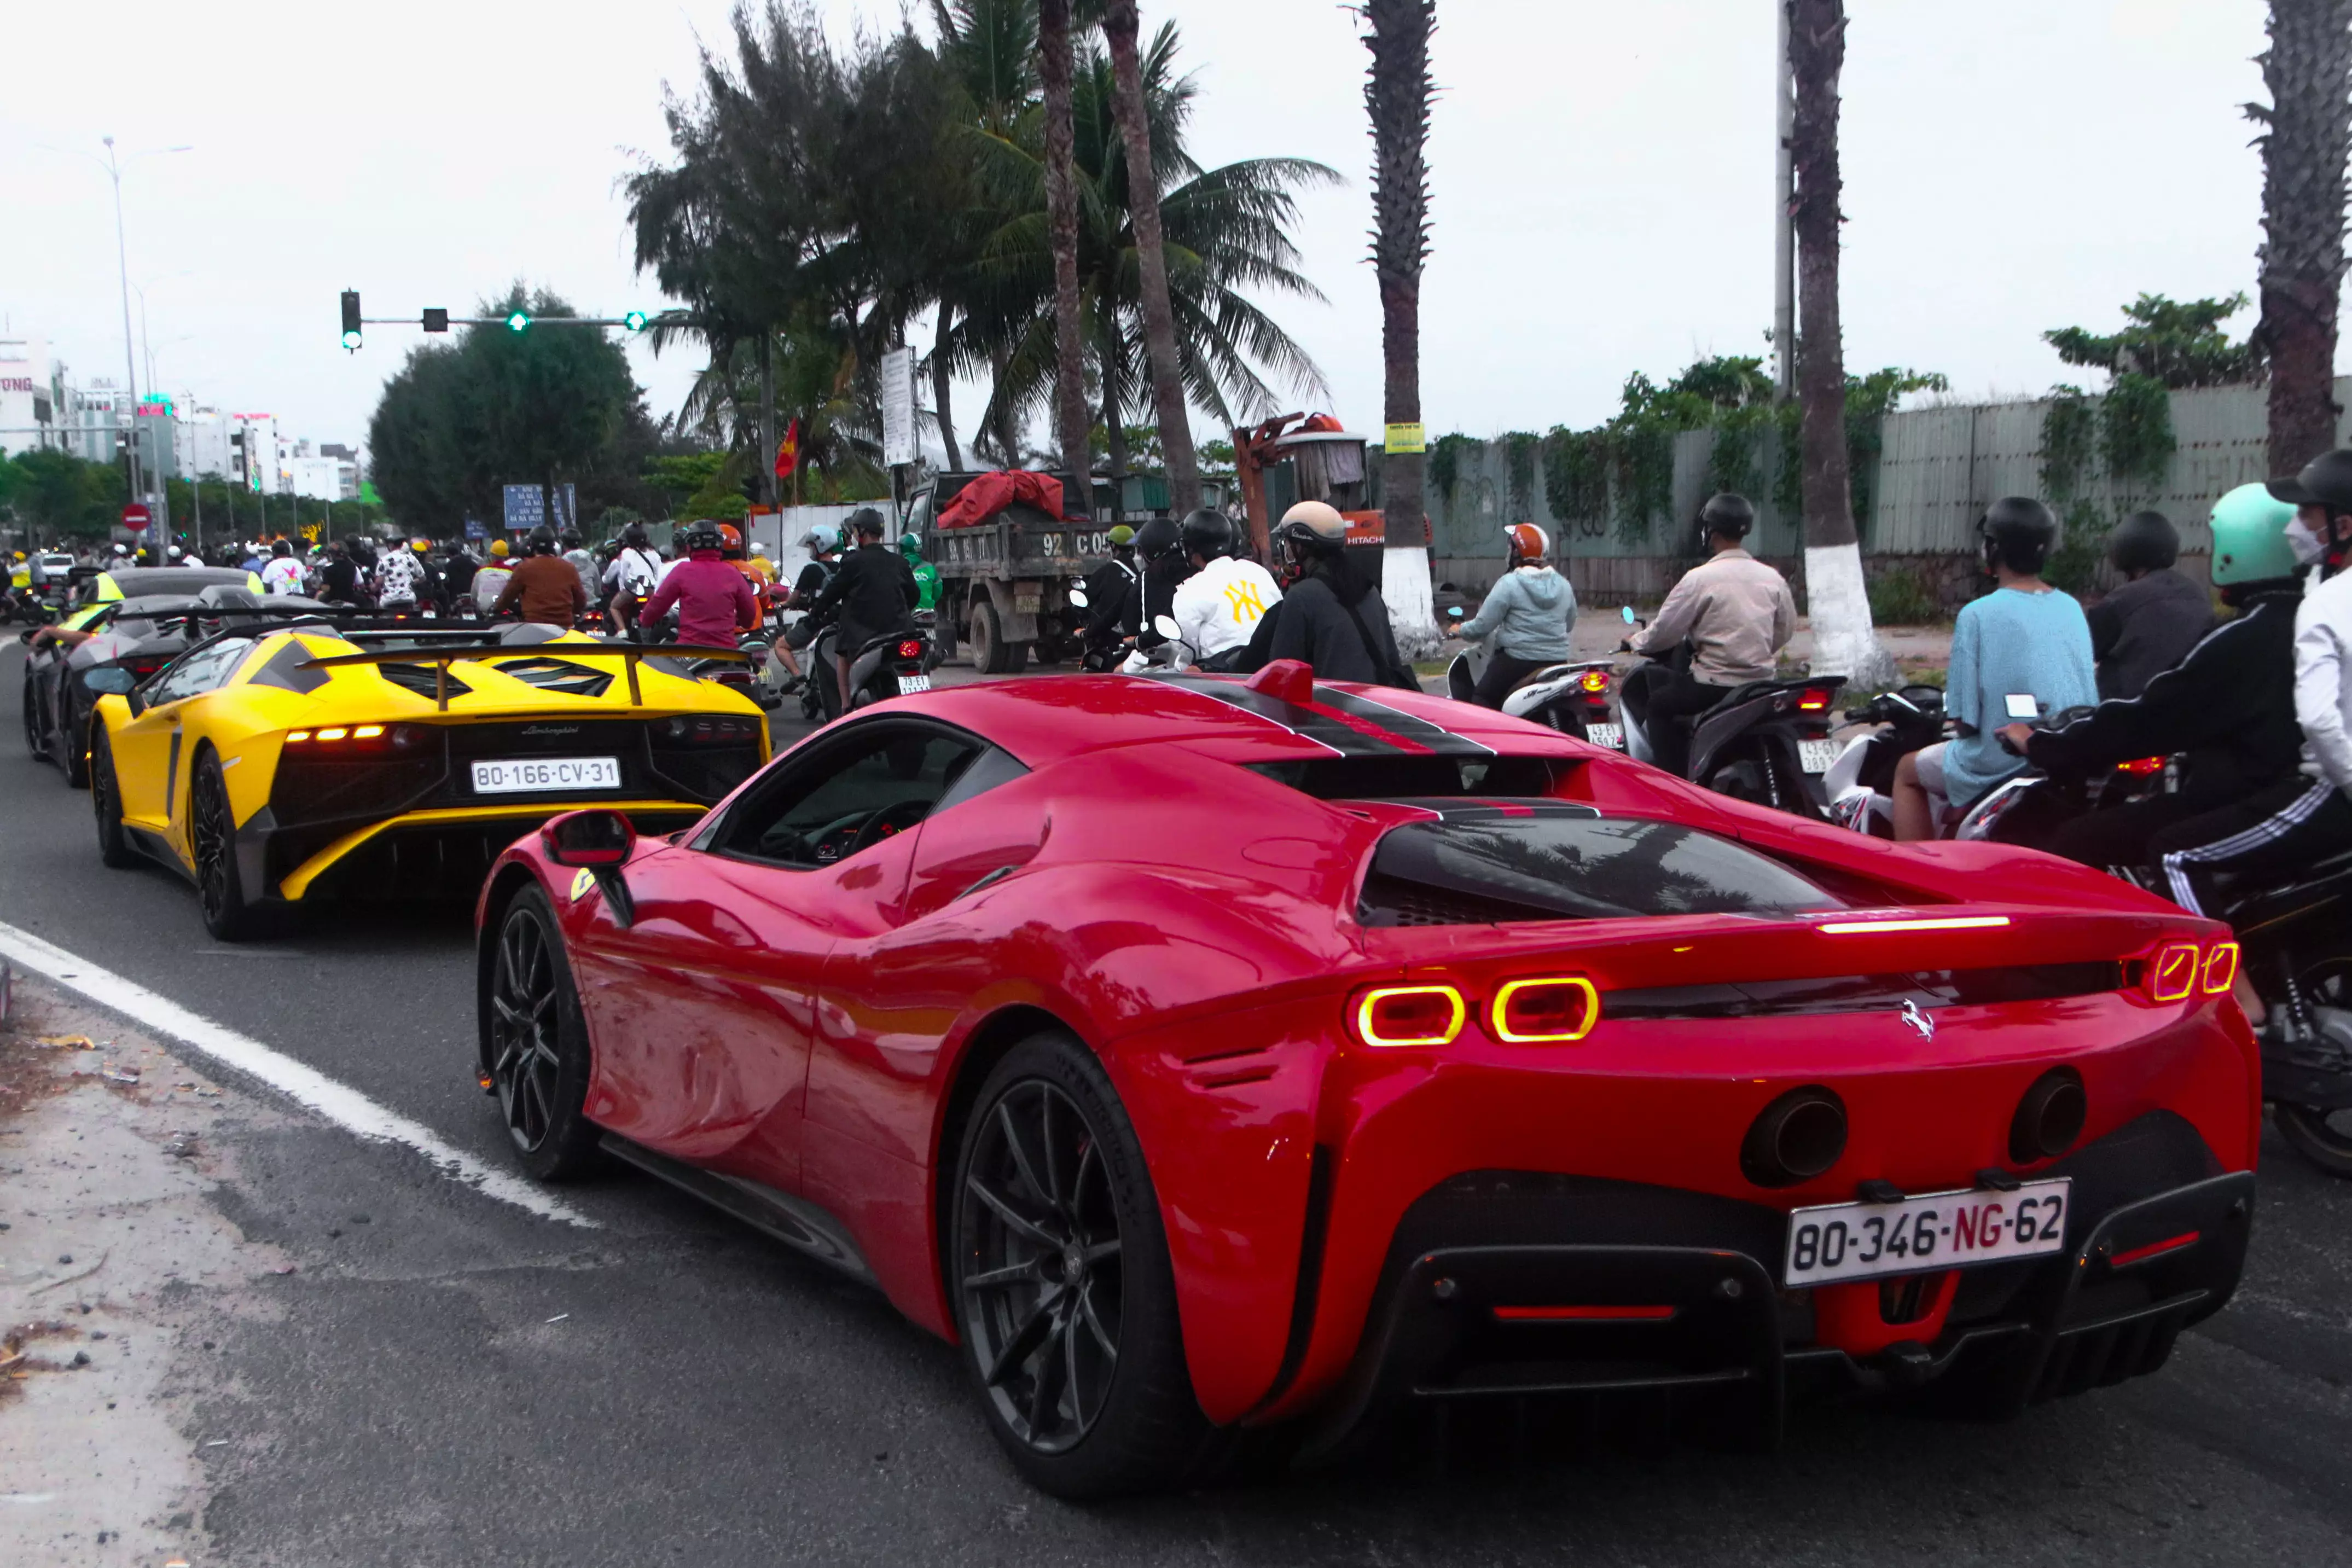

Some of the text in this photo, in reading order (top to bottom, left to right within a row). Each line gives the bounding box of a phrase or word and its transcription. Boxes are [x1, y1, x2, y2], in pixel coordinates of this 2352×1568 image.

[1043, 533, 1062, 556] 92
[1348, 536, 1385, 544] HITACHI
[1223, 580, 1267, 624] NY
[903, 677, 925, 686] 73-E1
[477, 763, 614, 786] 80-166-CV-31
[1793, 1195, 2063, 1270] 80-346-NG-62
